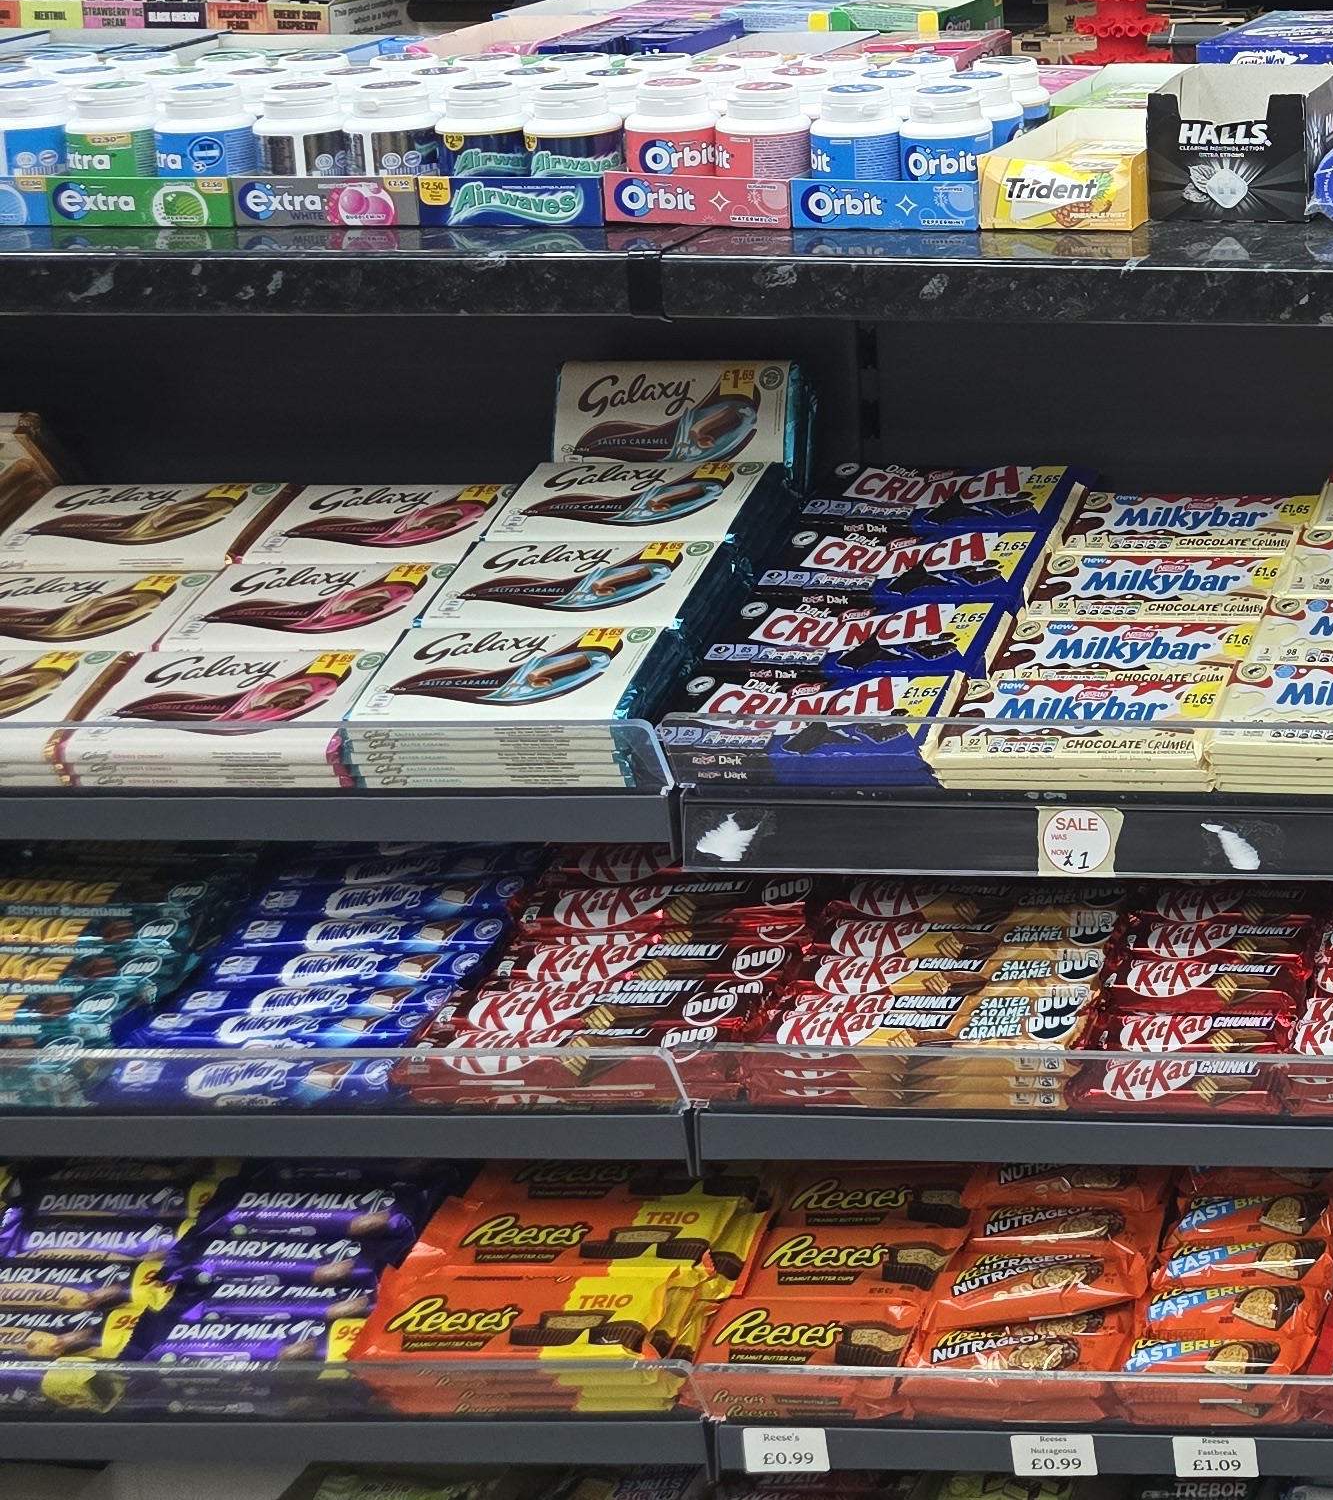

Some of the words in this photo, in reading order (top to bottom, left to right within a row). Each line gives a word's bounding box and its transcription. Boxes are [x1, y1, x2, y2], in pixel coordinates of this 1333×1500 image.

[1179, 123, 1272, 146] HALLS
[455, 185, 576, 213] Airwaves
[620, 186, 695, 213] Orbit
[1005, 177, 1097, 200] Trident
[578, 375, 695, 417] Galaxy
[598, 436, 628, 447] SALTED
[630, 436, 669, 447] CARAMEL
[760, 604, 943, 647] CRUNCH
[1047, 636, 1210, 663] Milkybar
[1054, 817, 1098, 831] SALE
[1108, 1062, 1196, 1097] KitKat
[1199, 1060, 1257, 1076] CHUNKY
[465, 1216, 591, 1250] Reese's
[763, 1432, 800, 1442] Reese's
[764, 1452, 814, 1467] £0.99
[1031, 1446, 1077, 1455] Nutrageous
[1197, 1448, 1237, 1456] Fastbreak
[1031, 1457, 1082, 1471] £0.99
[1193, 1458, 1241, 1472] £1.09
